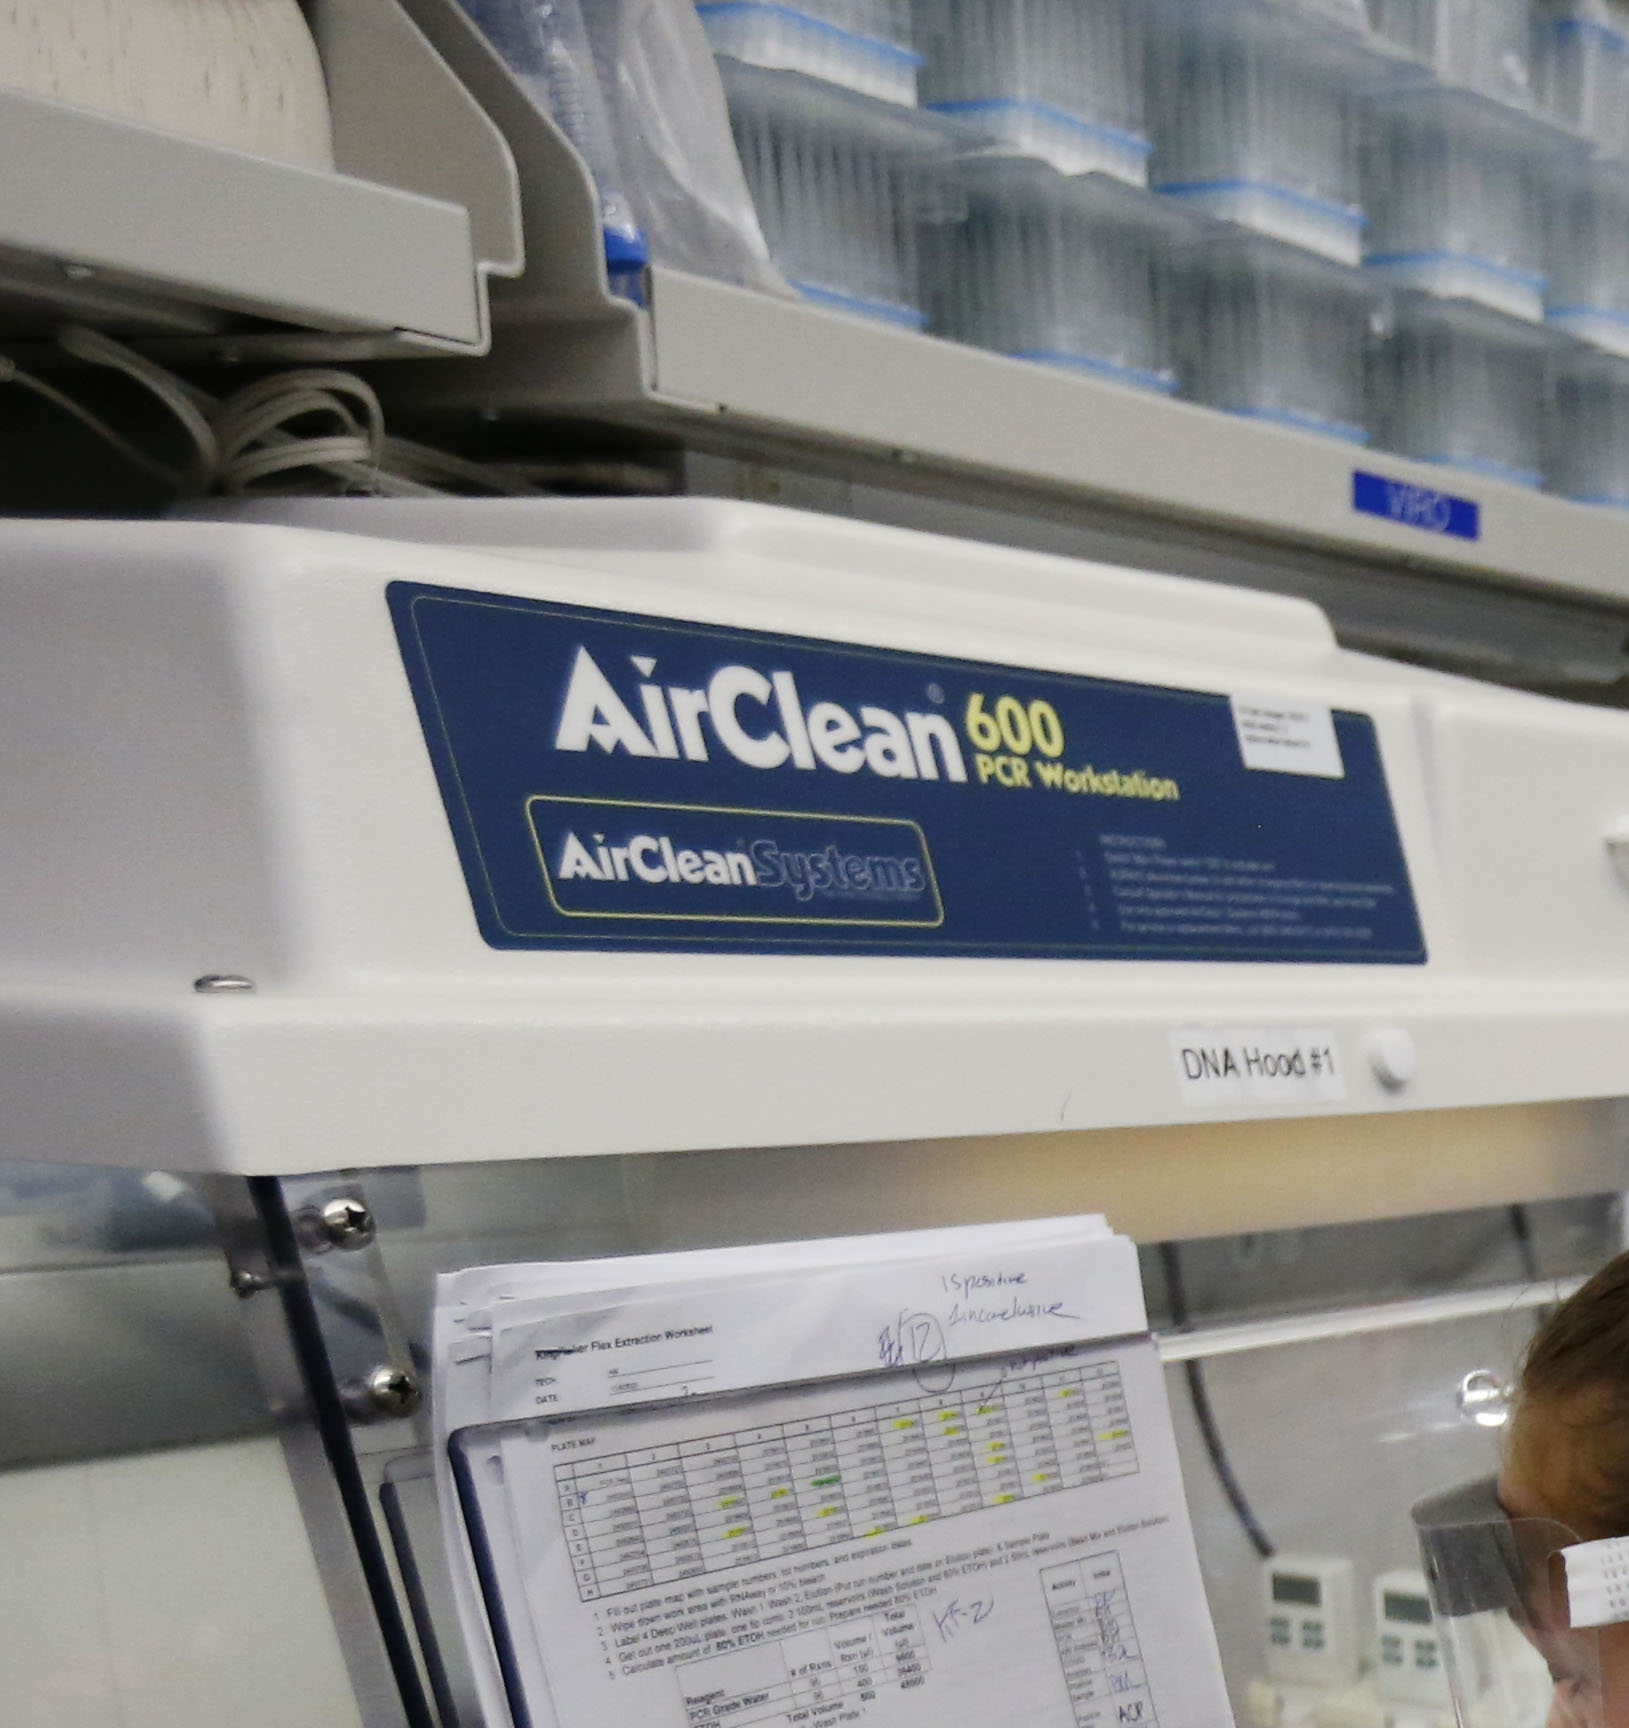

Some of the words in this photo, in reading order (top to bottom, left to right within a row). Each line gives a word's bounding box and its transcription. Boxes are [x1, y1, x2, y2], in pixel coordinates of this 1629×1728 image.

[555, 644, 967, 783] AirClean
[966, 692, 1063, 760] 600
[976, 755, 1029, 789] PCR
[1034, 761, 1180, 802] Workstation
[1181, 1046, 1238, 1082] DNA
[1244, 1044, 1305, 1078] Hood
[1310, 1044, 1337, 1075] #1
[591, 1340, 612, 1352] Flex
[615, 1333, 662, 1349] Extraction
[664, 1325, 713, 1340] Worksheet
[551, 1440, 576, 1452] PLATE
[578, 1436, 596, 1447] MAP
[706, 1578, 740, 1596] sample
[685, 1687, 726, 1709] Reagent
[810, 1699, 844, 1716] Volume
